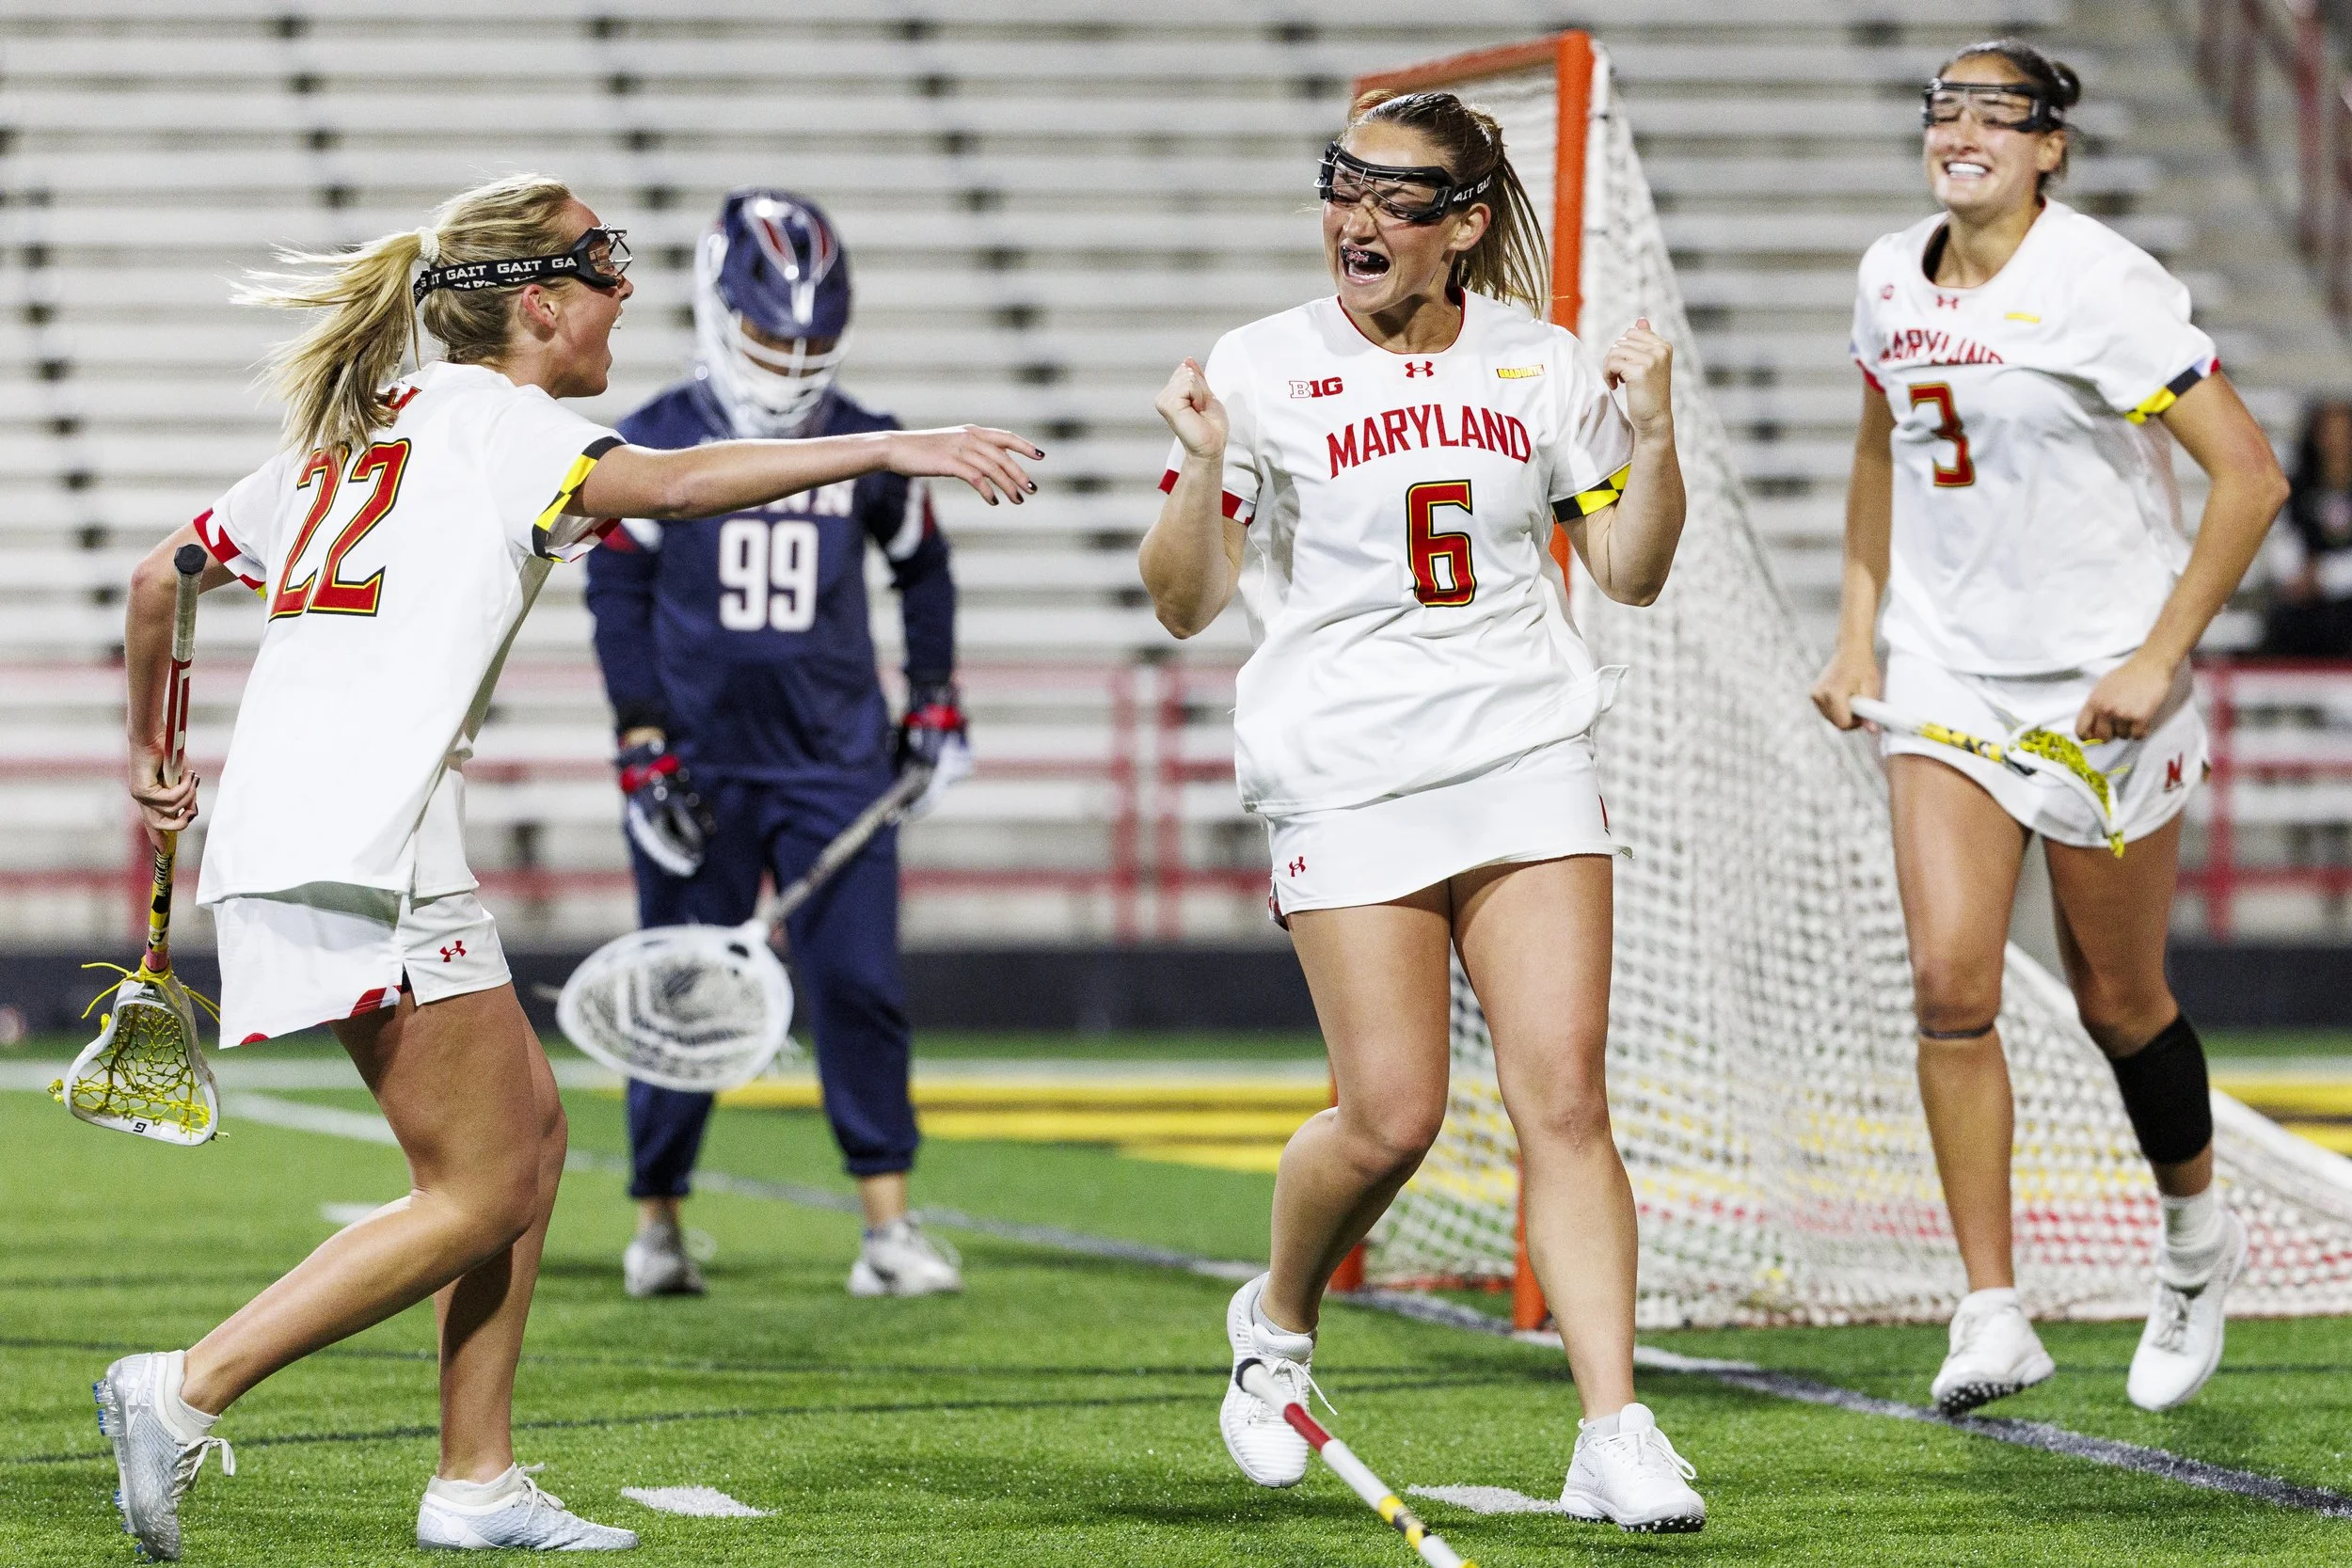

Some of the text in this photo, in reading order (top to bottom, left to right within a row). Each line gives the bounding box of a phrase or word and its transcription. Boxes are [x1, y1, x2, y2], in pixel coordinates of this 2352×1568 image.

[1453, 187, 1474, 202] AIT
[446, 265, 487, 280] GAIT
[497, 260, 542, 274] GAIT
[551, 257, 578, 269] GA
[1326, 404, 1532, 480] MARYLAND
[1907, 381, 1976, 487] 3
[268, 437, 412, 624] 22
[719, 518, 818, 632] 99
[1406, 479, 1477, 608] 6
